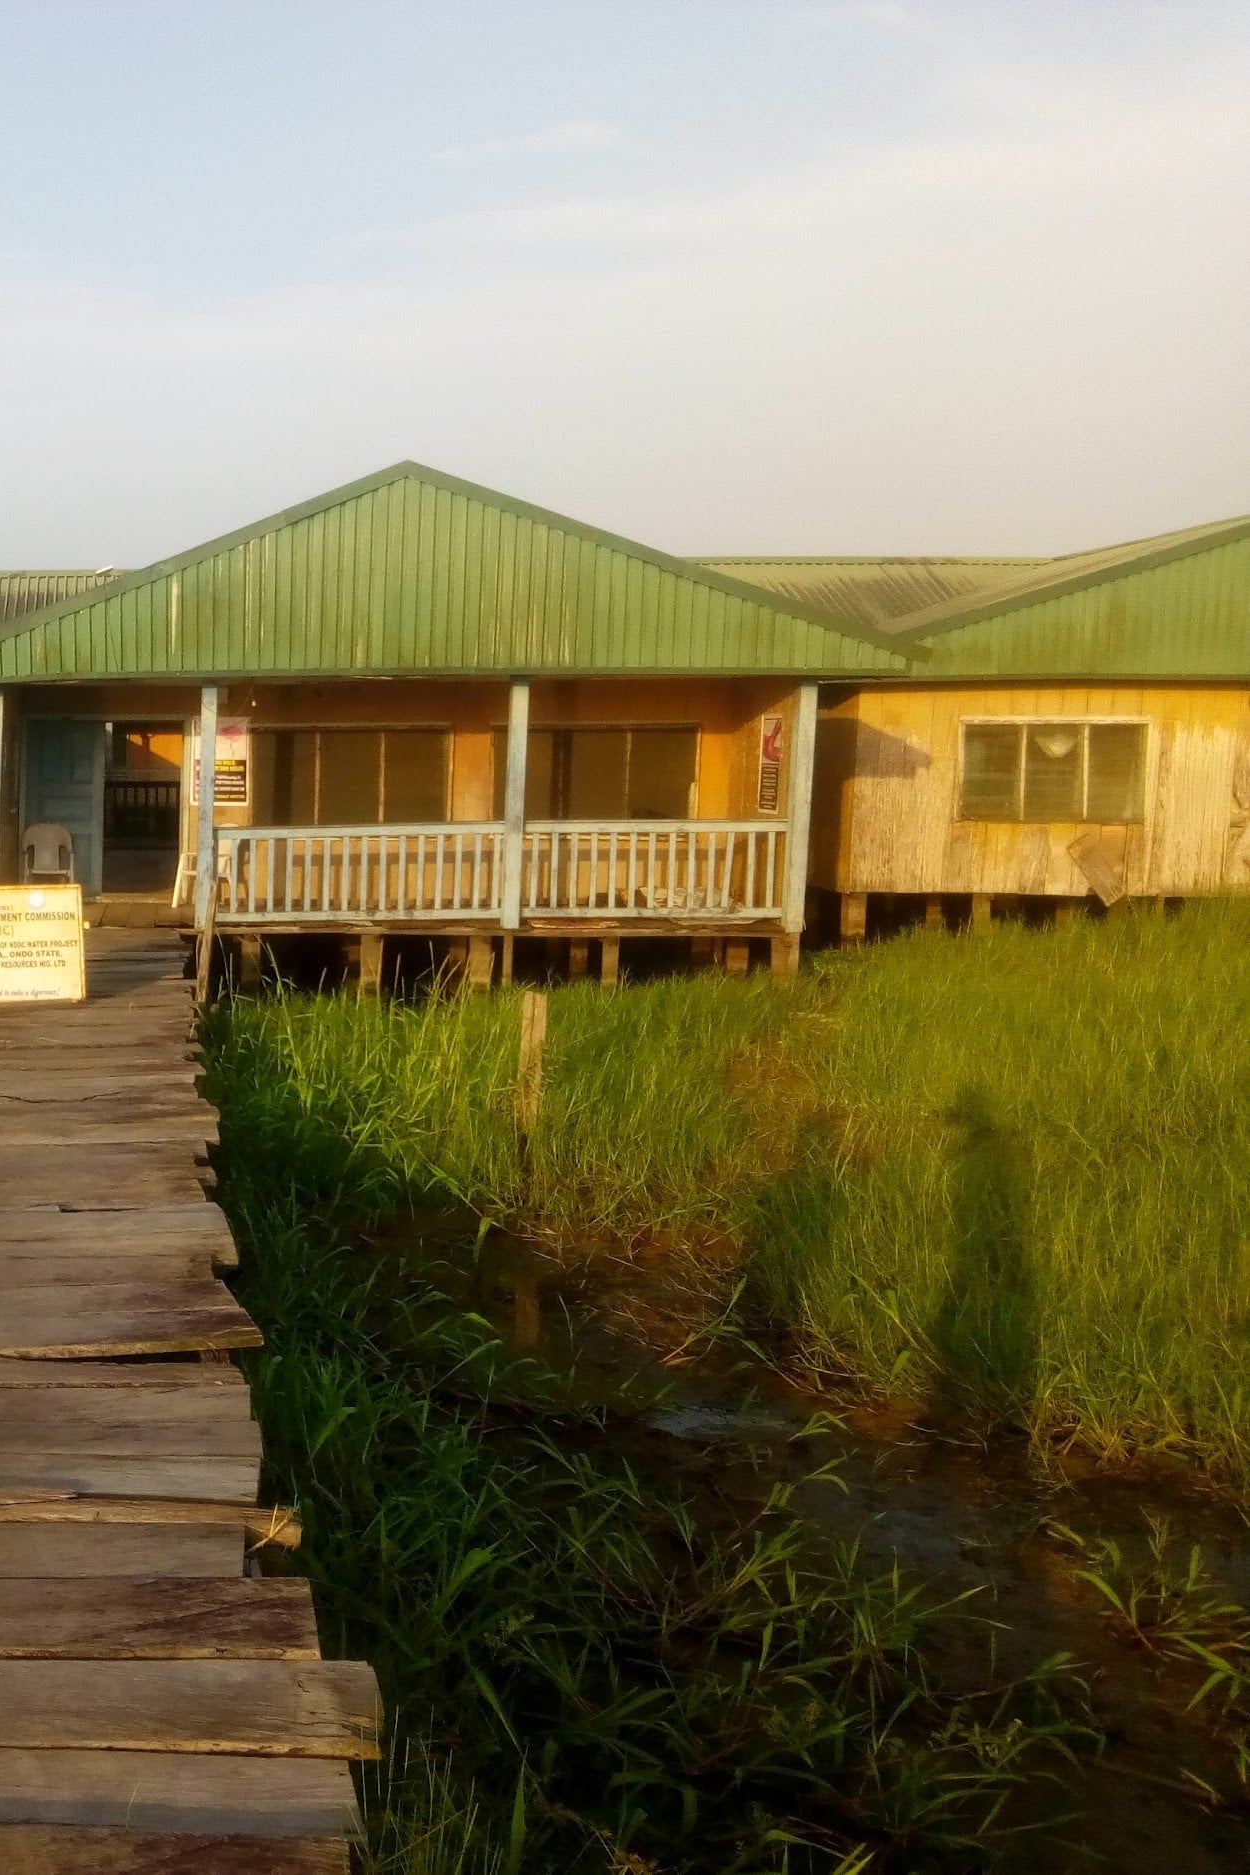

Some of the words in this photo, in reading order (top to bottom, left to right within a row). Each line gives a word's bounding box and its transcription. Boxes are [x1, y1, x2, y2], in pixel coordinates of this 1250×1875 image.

[24, 911, 75, 921] COMMISSION
[9, 941, 26, 949] NDDC
[27, 940, 48, 948] WATER
[50, 939, 78, 948] PROJECT
[1, 960, 37, 969] RESOURCES
[54, 959, 66, 967] LTD
